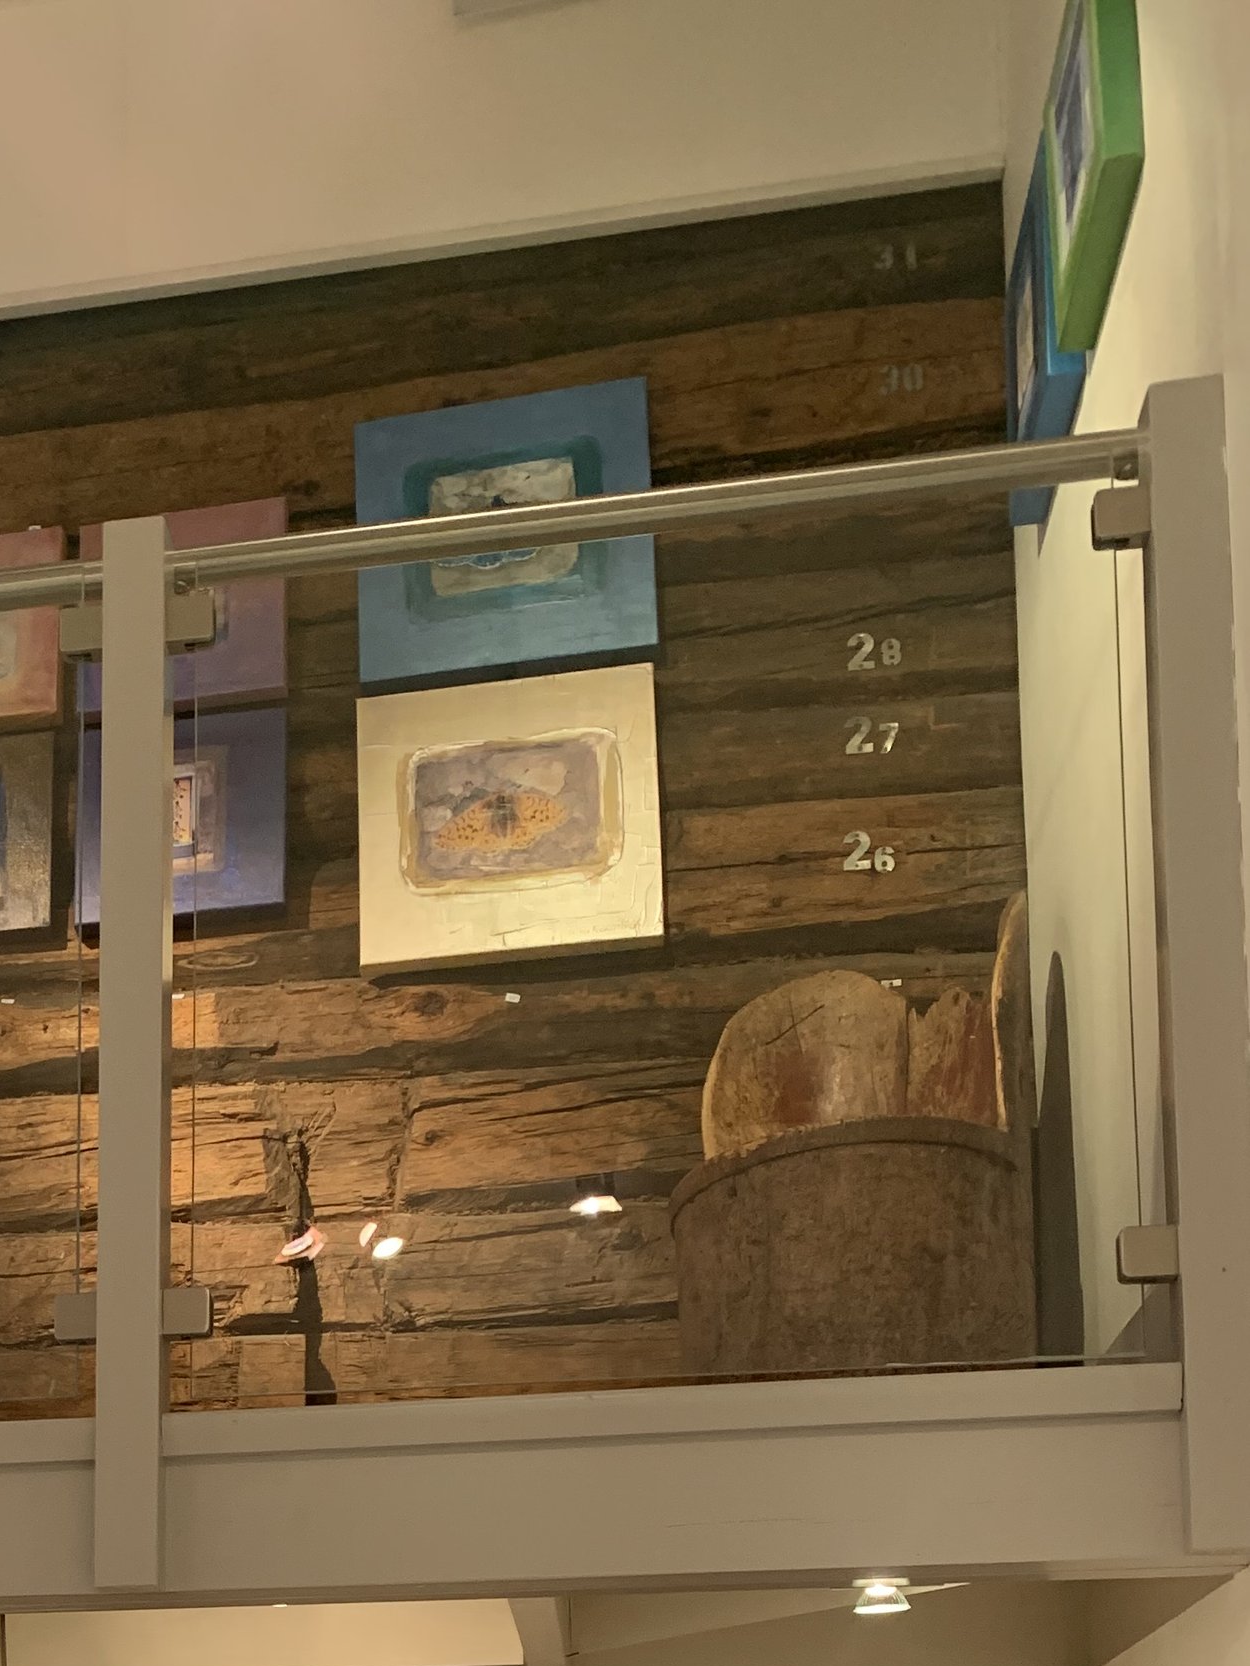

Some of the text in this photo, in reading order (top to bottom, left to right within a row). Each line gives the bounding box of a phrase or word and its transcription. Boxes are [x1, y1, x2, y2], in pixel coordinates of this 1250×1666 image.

[846, 632, 902, 671] 28
[844, 716, 899, 754] 27
[843, 831, 896, 874] 26
